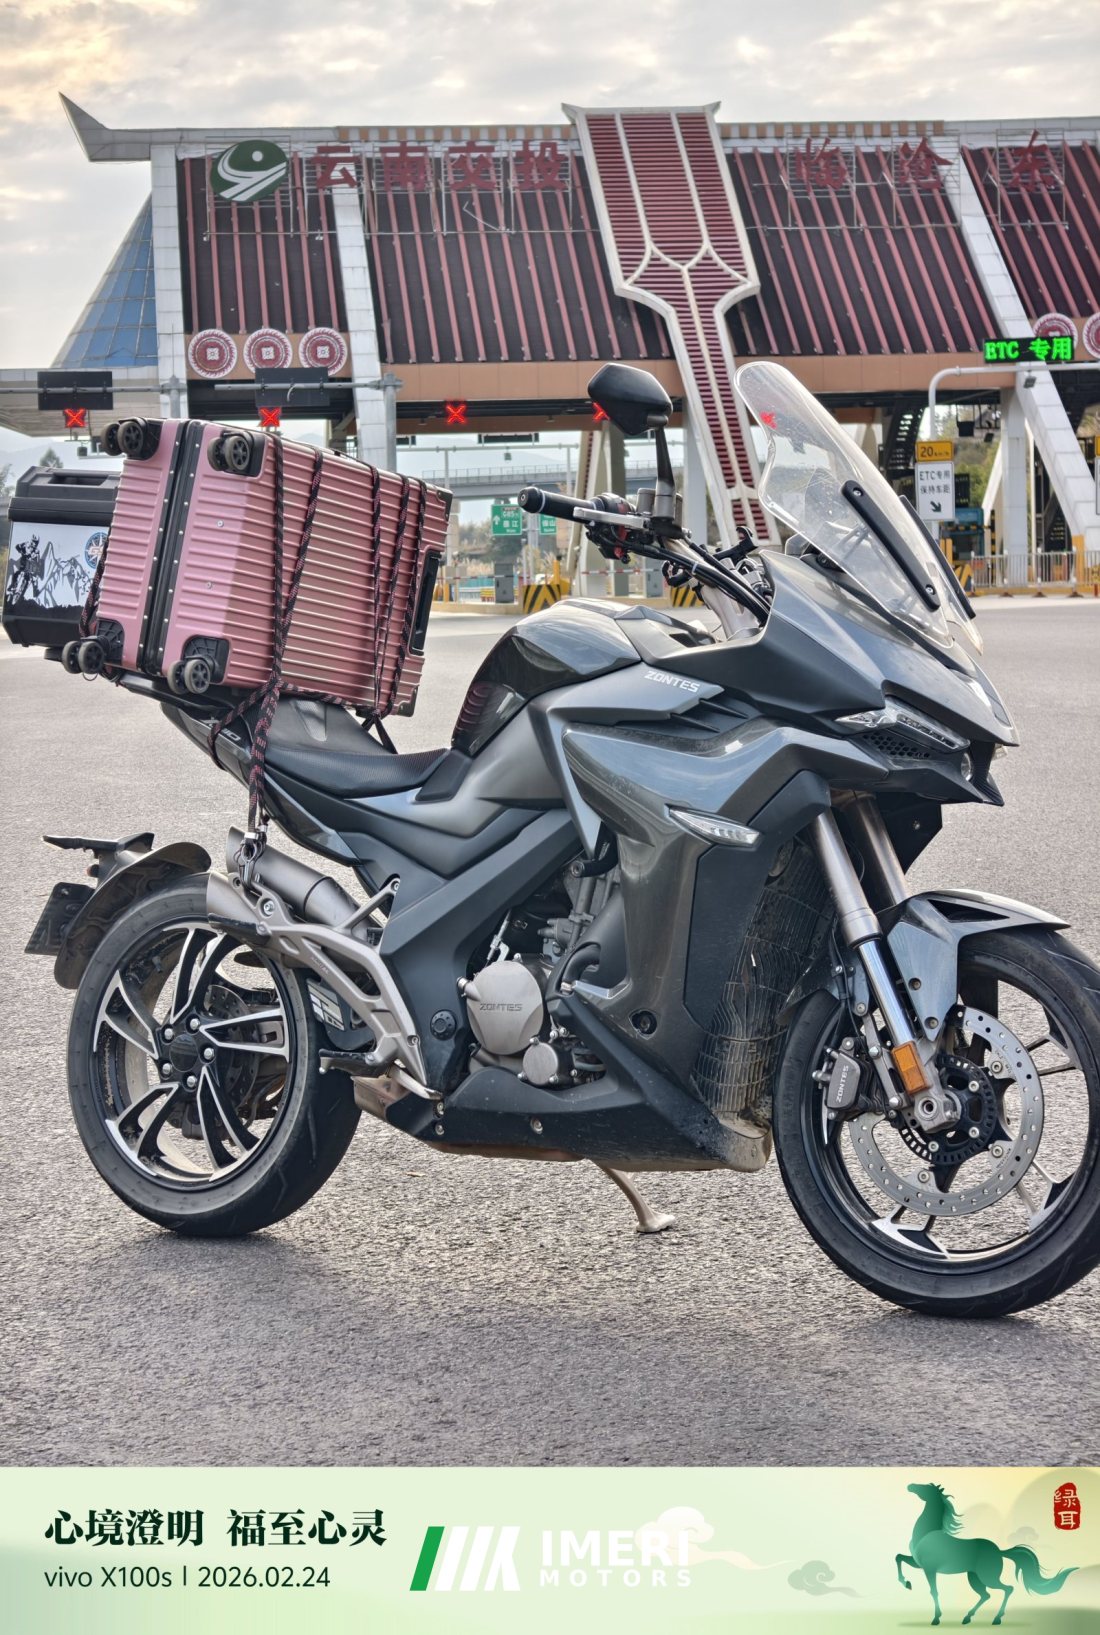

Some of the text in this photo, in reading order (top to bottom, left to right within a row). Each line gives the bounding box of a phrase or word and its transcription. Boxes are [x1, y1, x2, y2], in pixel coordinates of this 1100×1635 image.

[310, 140, 566, 192] 云南交投
[985, 337, 1073, 361] ETC 专用
[644, 670, 700, 693] ZONTES
[480, 1003, 523, 1012] ZONTES
[836, 1065, 849, 1103] ZONTES
